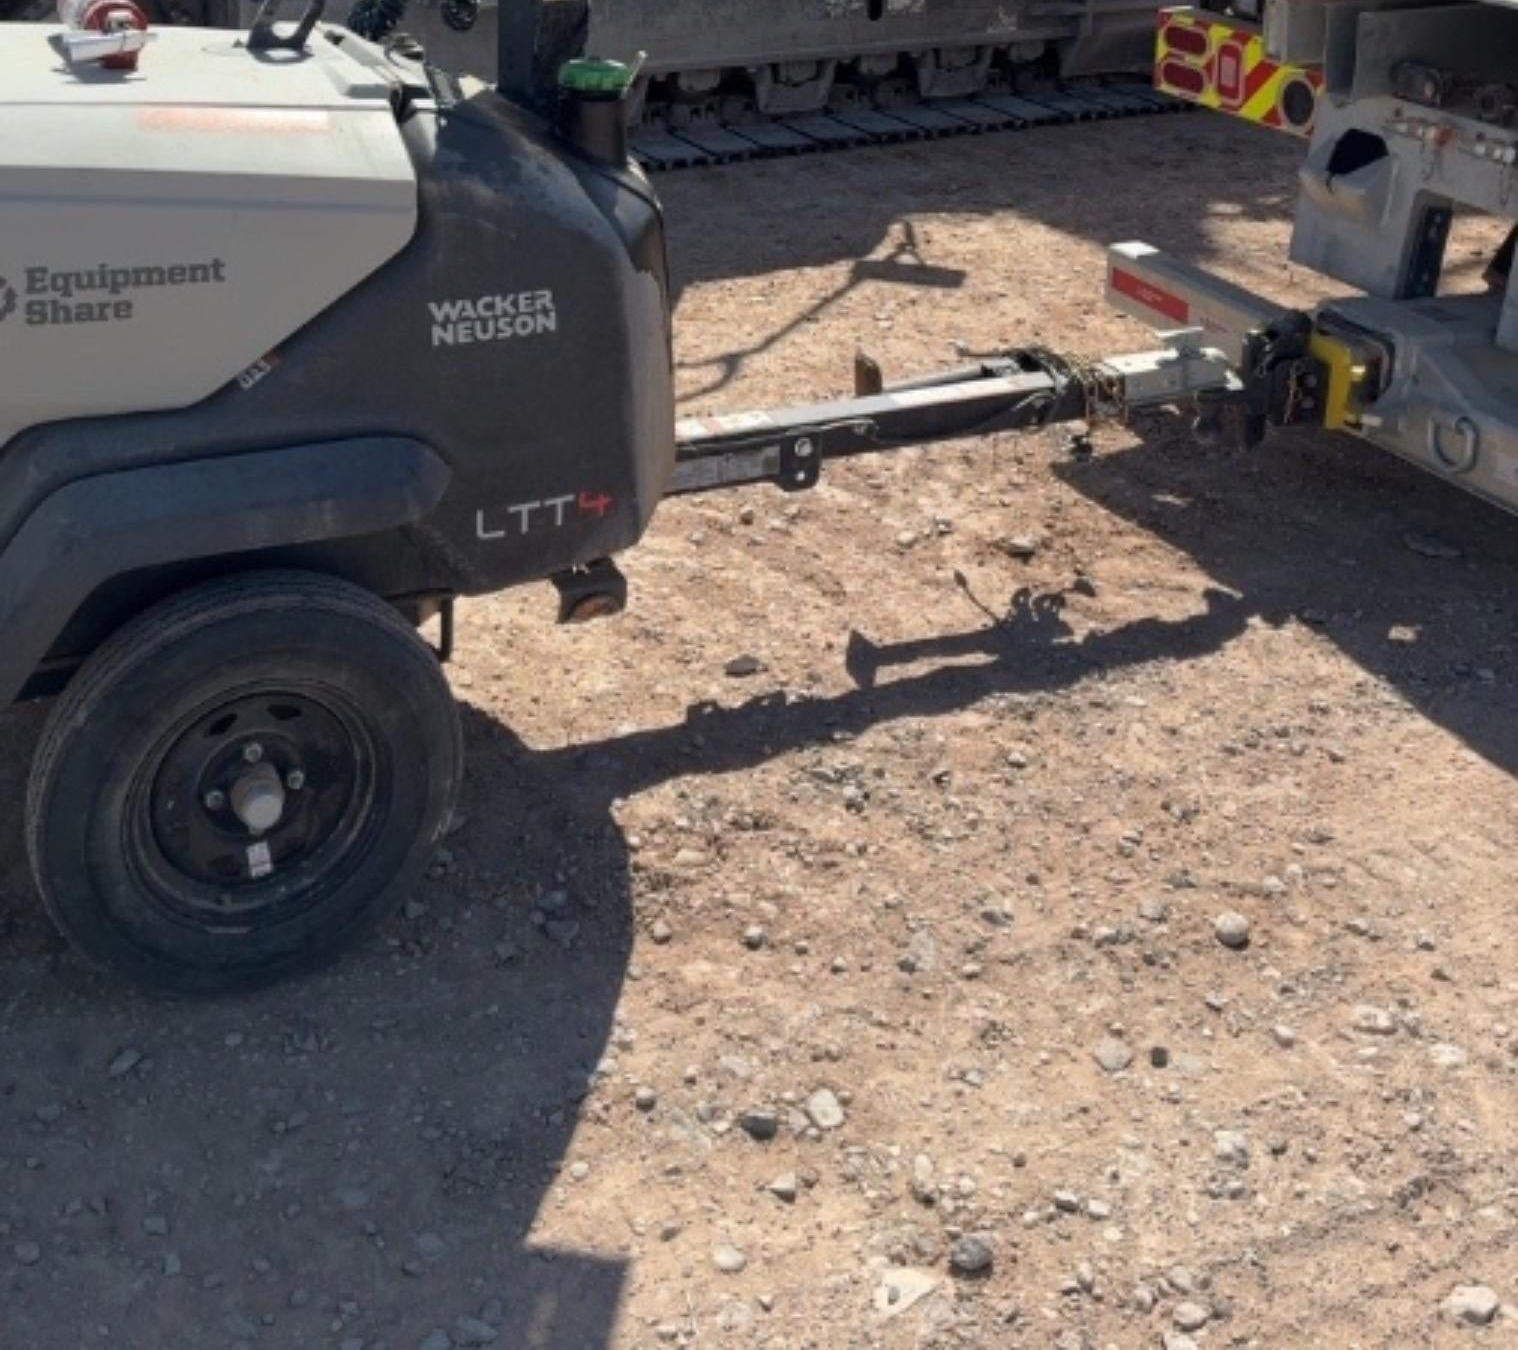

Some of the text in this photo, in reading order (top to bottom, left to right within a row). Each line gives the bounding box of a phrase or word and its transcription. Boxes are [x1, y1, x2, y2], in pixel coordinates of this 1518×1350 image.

[24, 257, 226, 298] Equipment
[24, 299, 133, 326] Share
[427, 289, 556, 323] WACKER
[431, 310, 557, 347] NEUSON
[476, 490, 616, 540] LTT4
